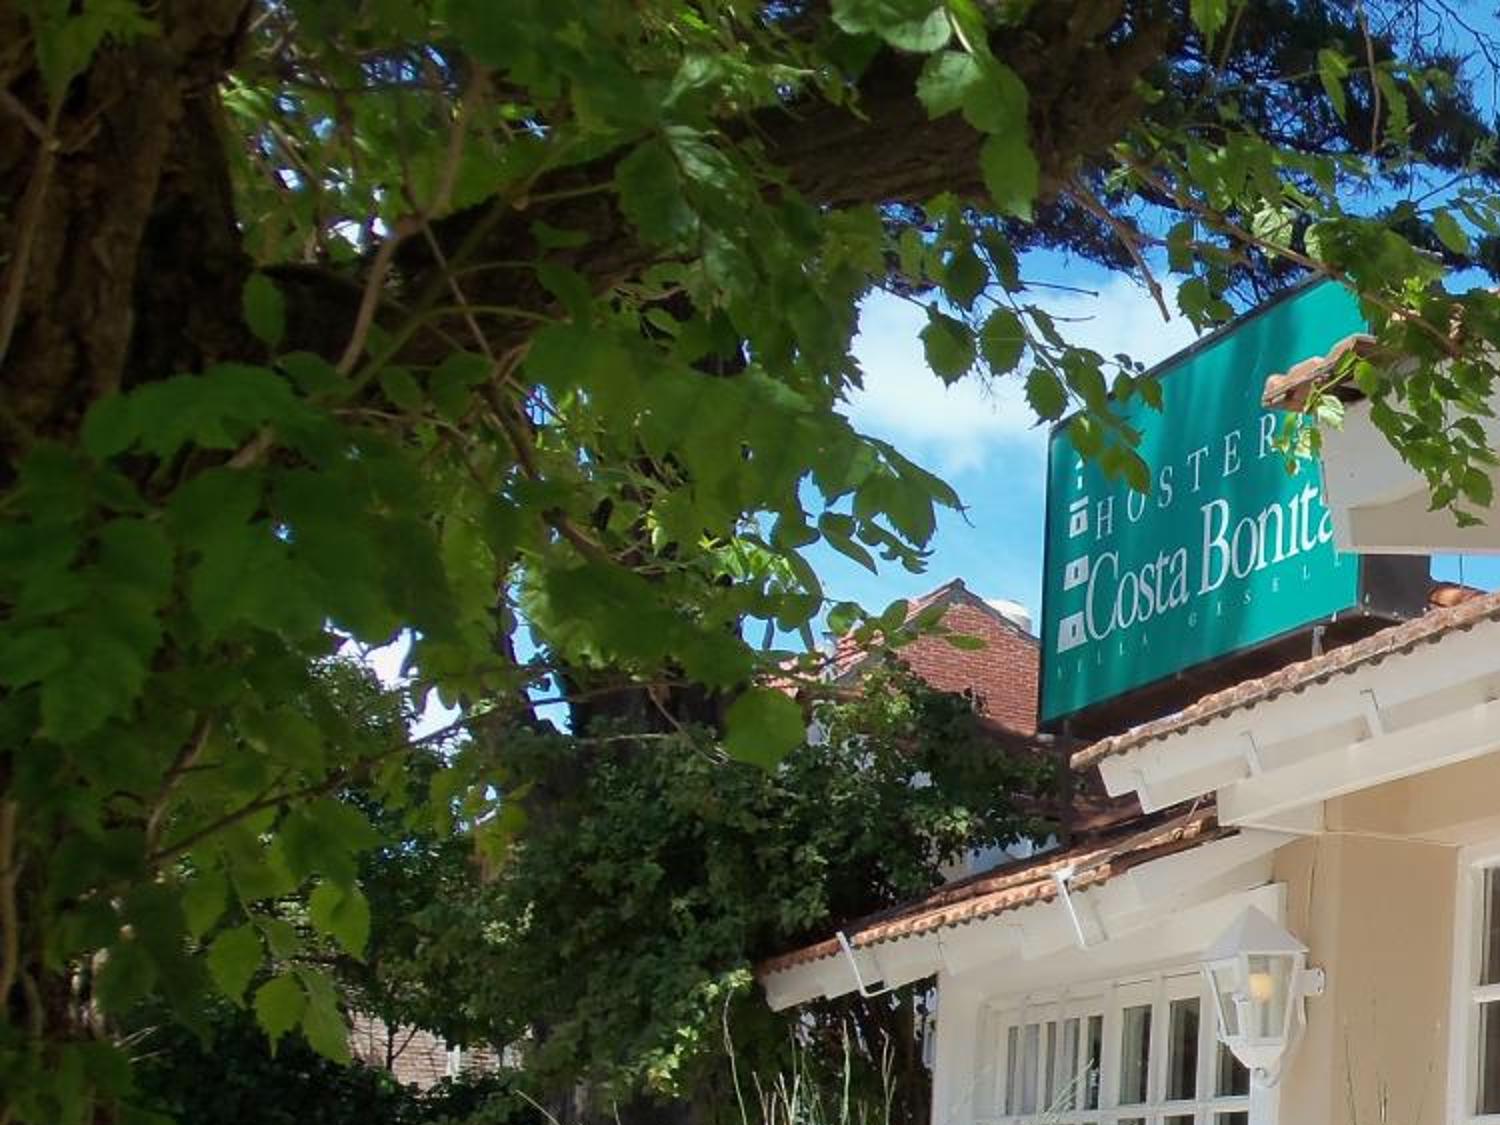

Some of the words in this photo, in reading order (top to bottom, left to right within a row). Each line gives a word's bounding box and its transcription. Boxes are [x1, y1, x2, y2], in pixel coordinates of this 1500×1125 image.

[1095, 411, 1304, 541] HOSTER
[1086, 546, 1190, 640] Costa
[1197, 481, 1334, 596] Bonita
